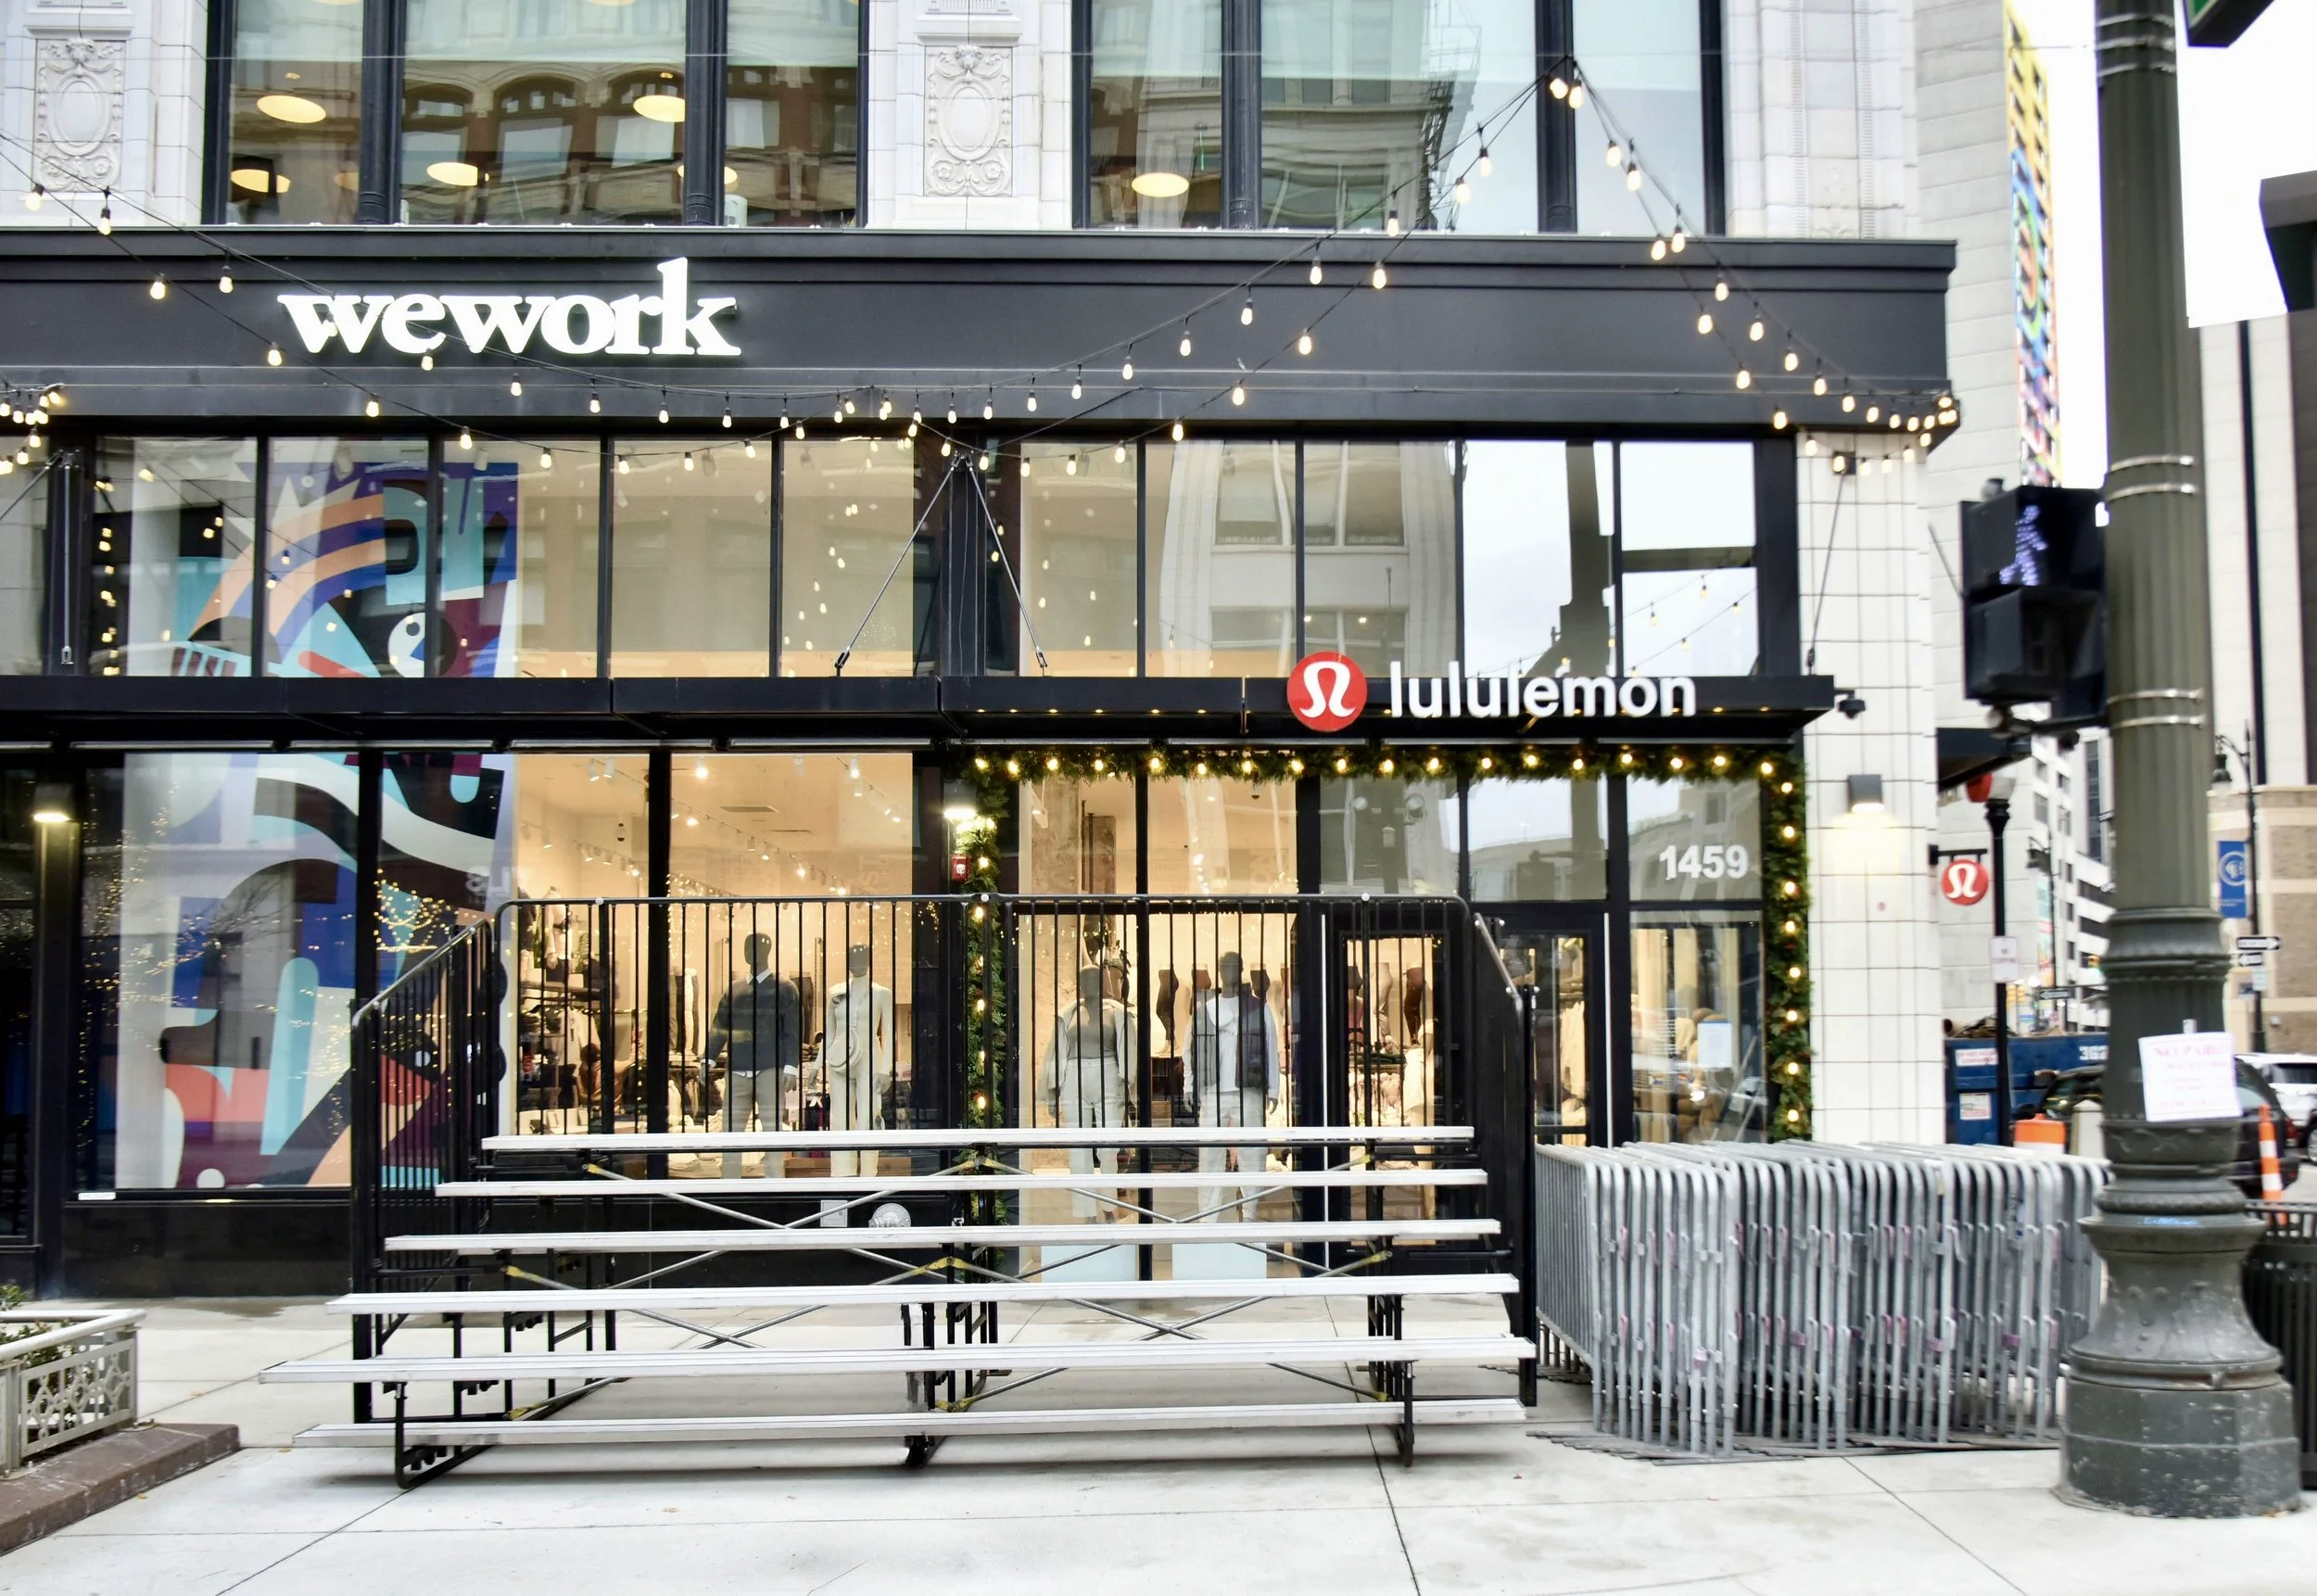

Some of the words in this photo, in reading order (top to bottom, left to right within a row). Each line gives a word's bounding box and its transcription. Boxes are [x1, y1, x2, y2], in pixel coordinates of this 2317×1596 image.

[277, 257, 741, 357] wework
[1389, 660, 1697, 718] lululemon
[1659, 844, 1748, 880] 1459
